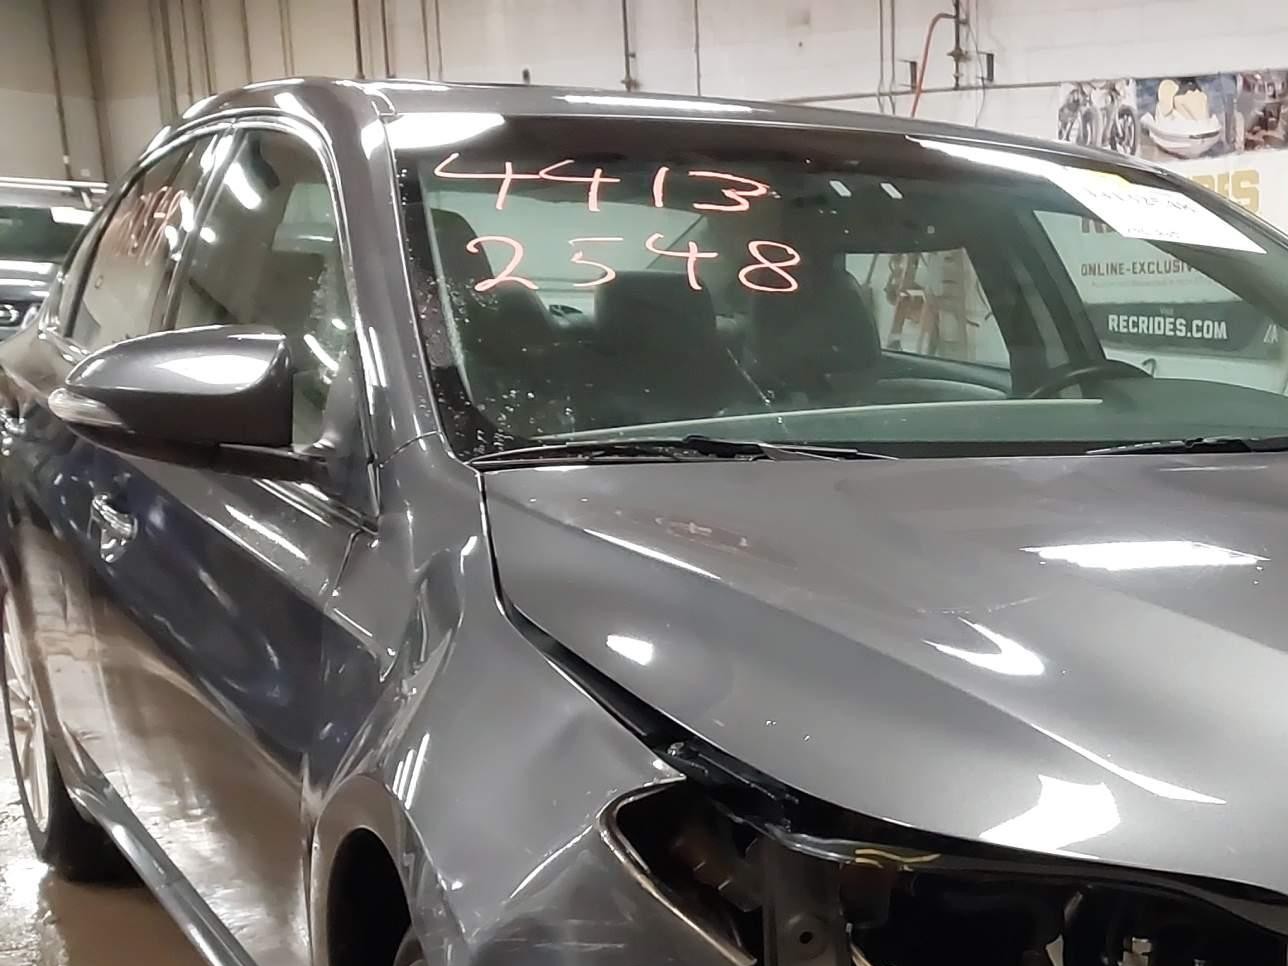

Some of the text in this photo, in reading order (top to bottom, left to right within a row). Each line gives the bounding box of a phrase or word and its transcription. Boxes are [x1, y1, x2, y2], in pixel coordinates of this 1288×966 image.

[434, 152, 770, 212] 4413
[466, 232, 801, 292] 2548
[1108, 314, 1228, 340] RECRIDES.COM
